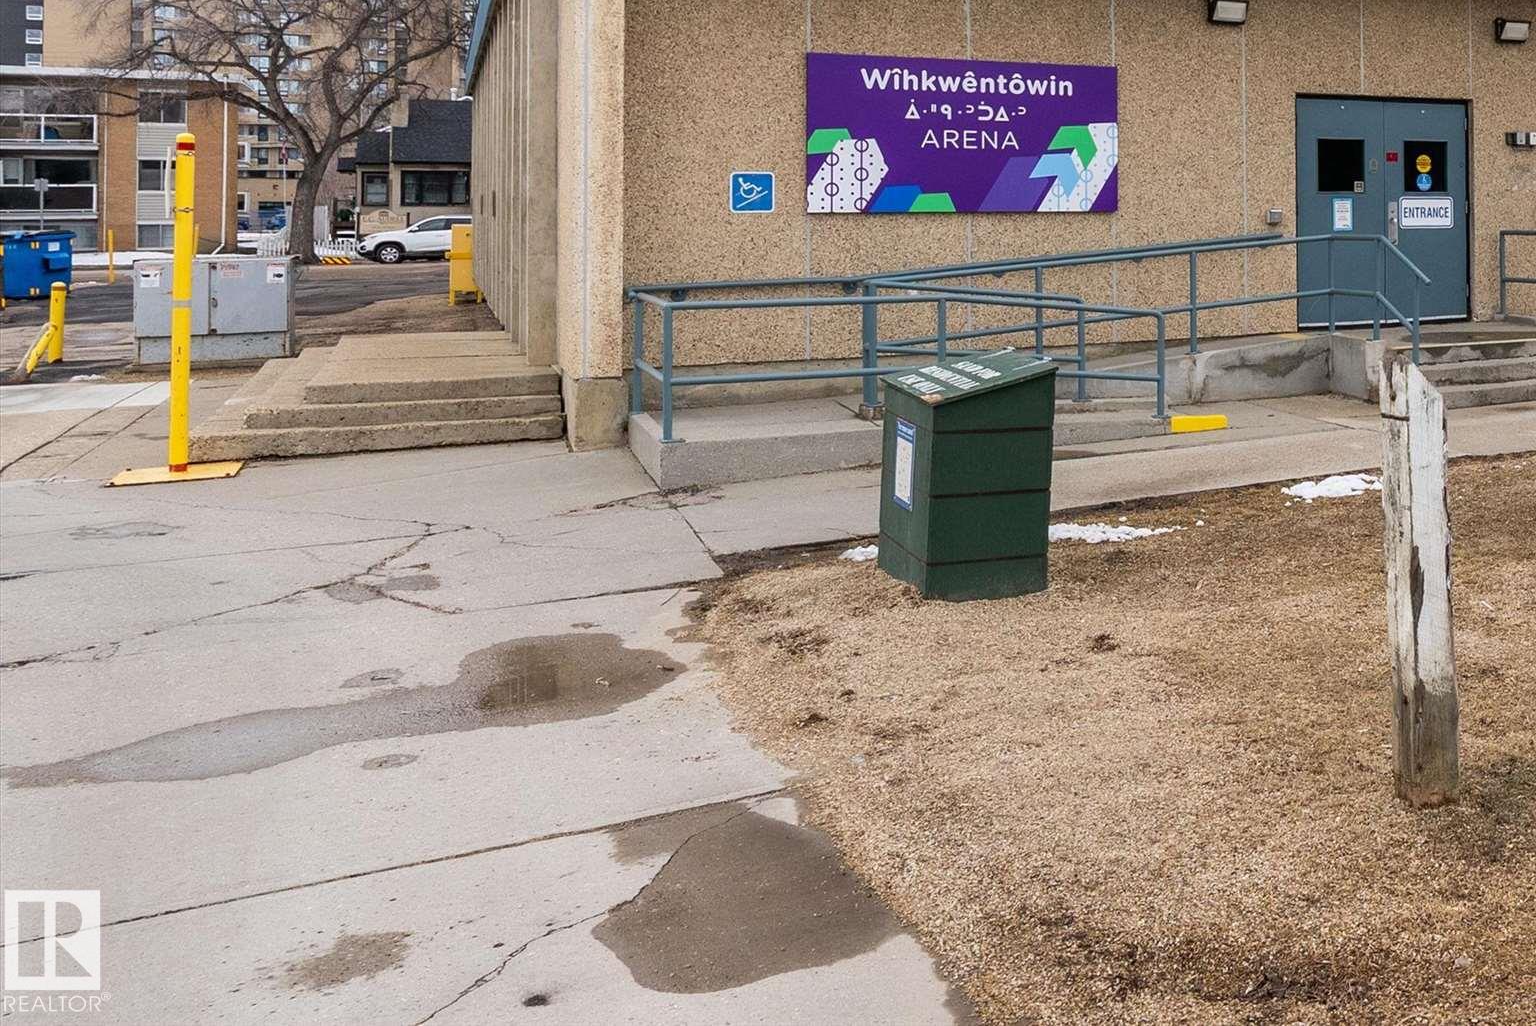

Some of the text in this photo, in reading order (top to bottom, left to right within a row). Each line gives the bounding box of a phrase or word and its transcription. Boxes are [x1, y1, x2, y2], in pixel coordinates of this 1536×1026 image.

[860, 67, 1074, 97] Wîhkwêntôwin
[920, 128, 1020, 151] ARENA
[1403, 206, 1450, 219] ENTRANCE
